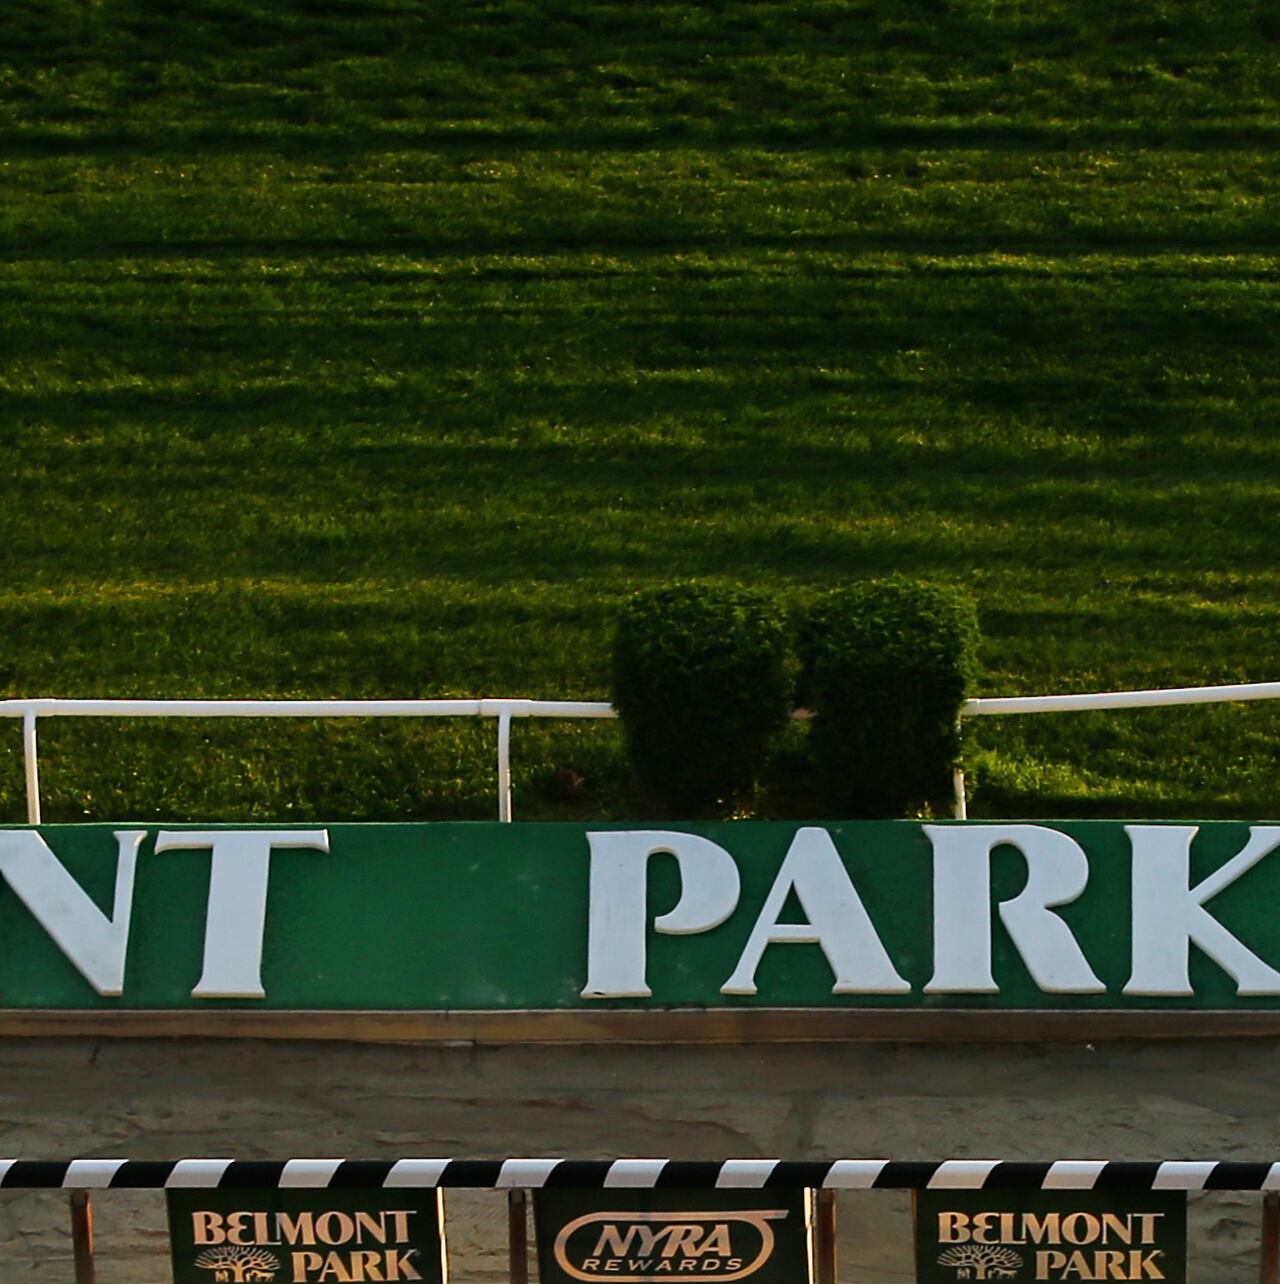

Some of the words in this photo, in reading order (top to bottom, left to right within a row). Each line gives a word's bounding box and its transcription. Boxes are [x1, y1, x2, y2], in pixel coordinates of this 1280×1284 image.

[192, 1210, 418, 1246] BELMONT
[592, 1223, 733, 1258] NYRA
[938, 1211, 1166, 1245] BELMONT
[291, 1249, 423, 1284] PARK
[581, 1258, 744, 1272] REWARDS
[1035, 1249, 1166, 1281] PARK
